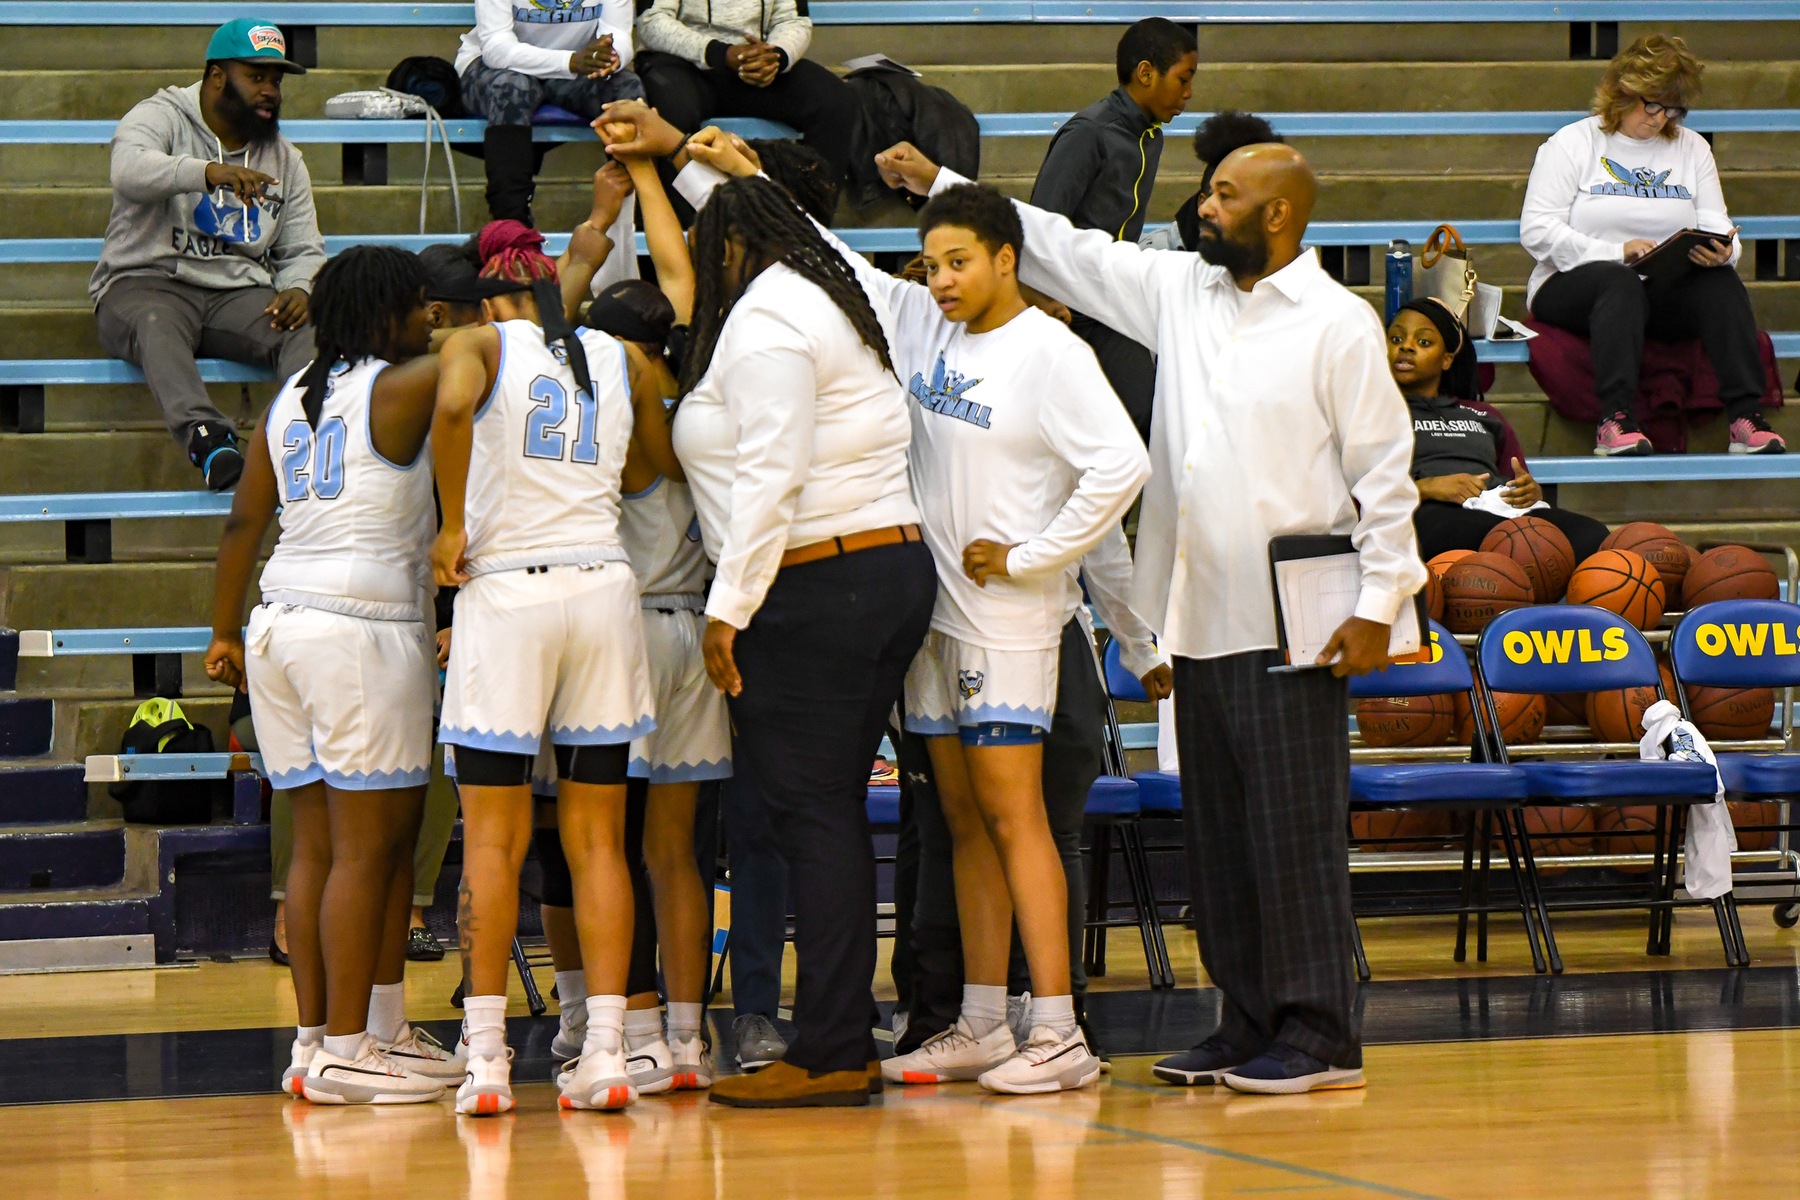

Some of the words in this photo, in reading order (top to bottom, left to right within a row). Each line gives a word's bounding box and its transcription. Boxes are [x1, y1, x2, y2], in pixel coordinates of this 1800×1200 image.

[172, 226, 234, 257] EAGLE
[523, 374, 599, 465] 21
[1414, 420, 1487, 434] ADENSBURG
[281, 415, 348, 502] 20
[1502, 626, 1630, 665] OWLS
[1695, 622, 1800, 657] OWL
